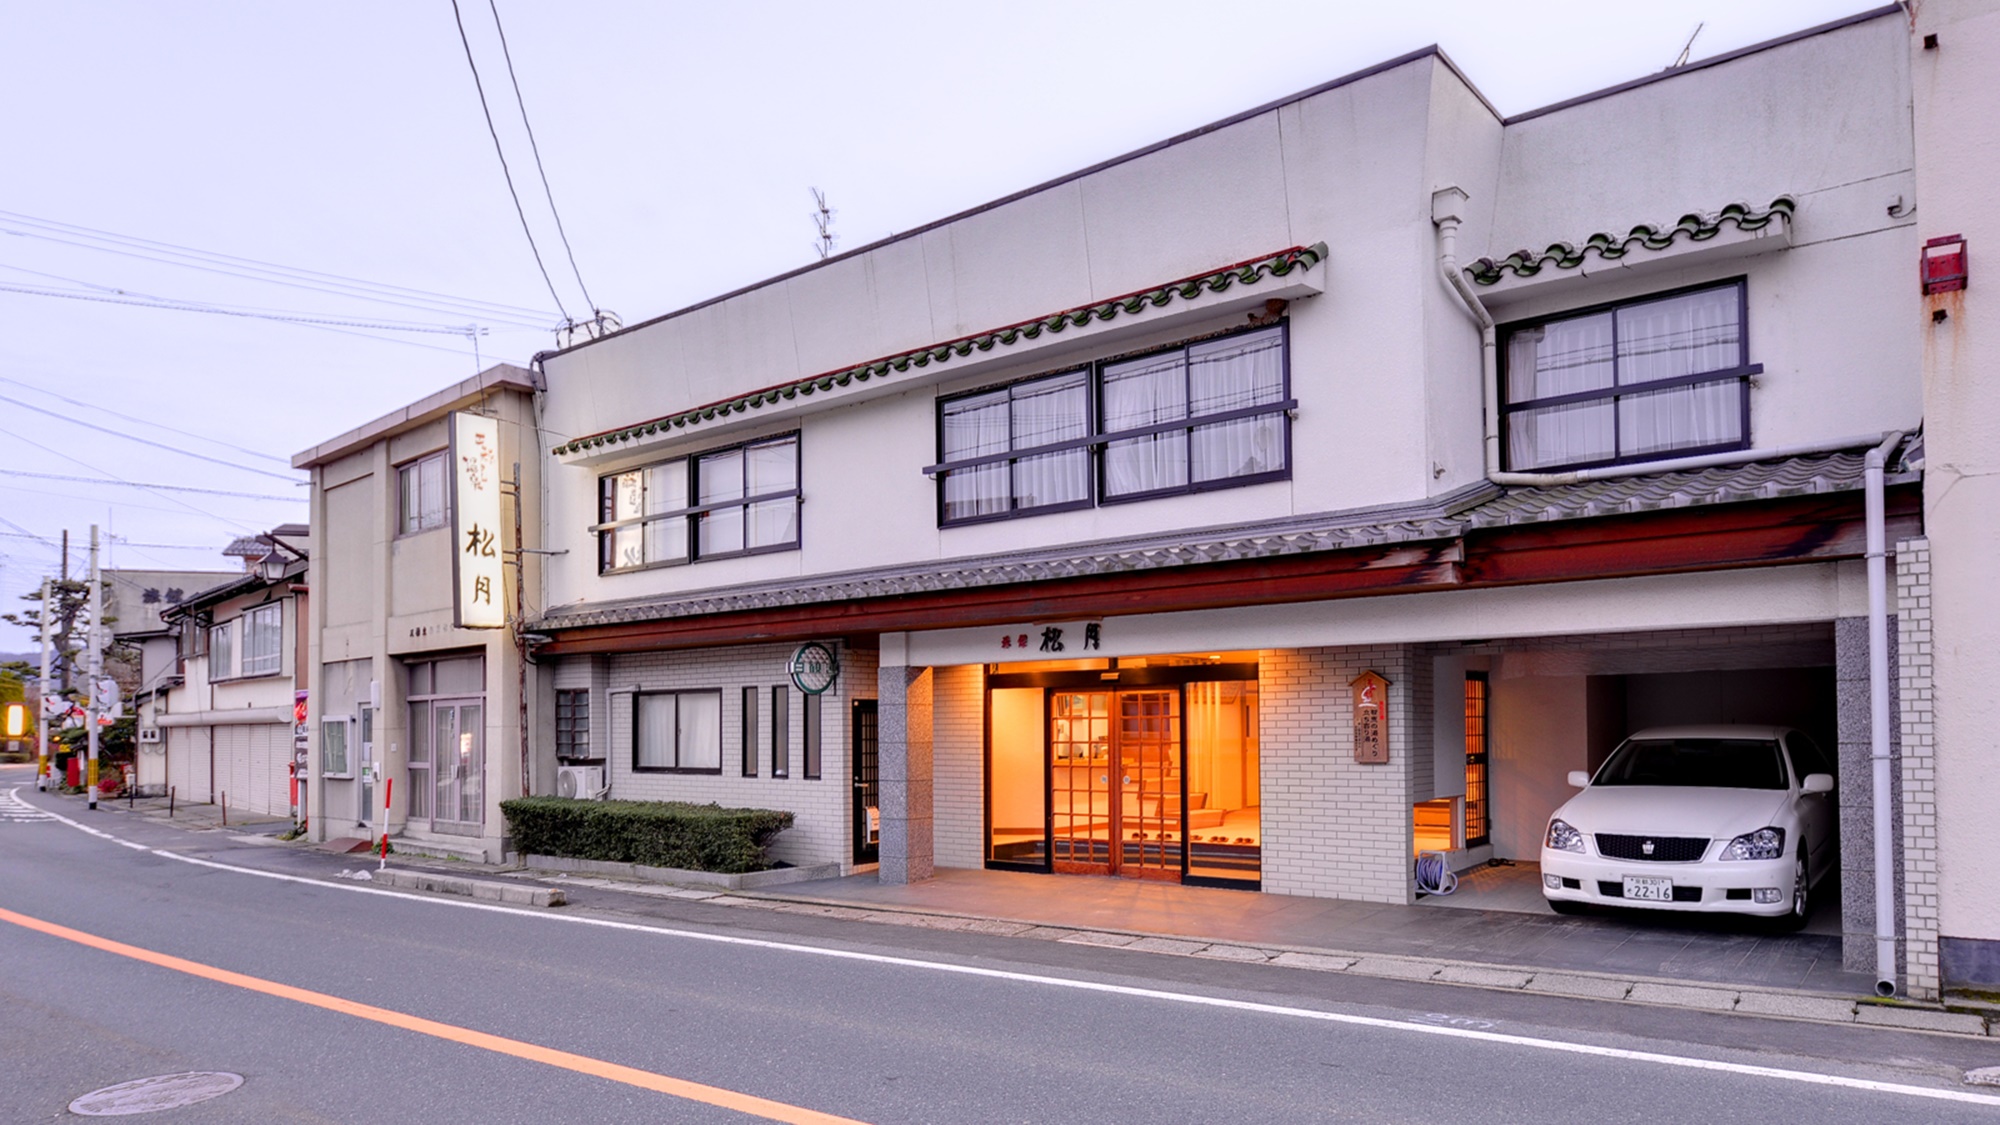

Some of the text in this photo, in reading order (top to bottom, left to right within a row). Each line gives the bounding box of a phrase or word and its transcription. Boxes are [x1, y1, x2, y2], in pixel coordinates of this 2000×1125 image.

[466, 522, 497, 605] 松月
[1039, 622, 1102, 652] 松月
[1634, 885, 1670, 900] 22-16
